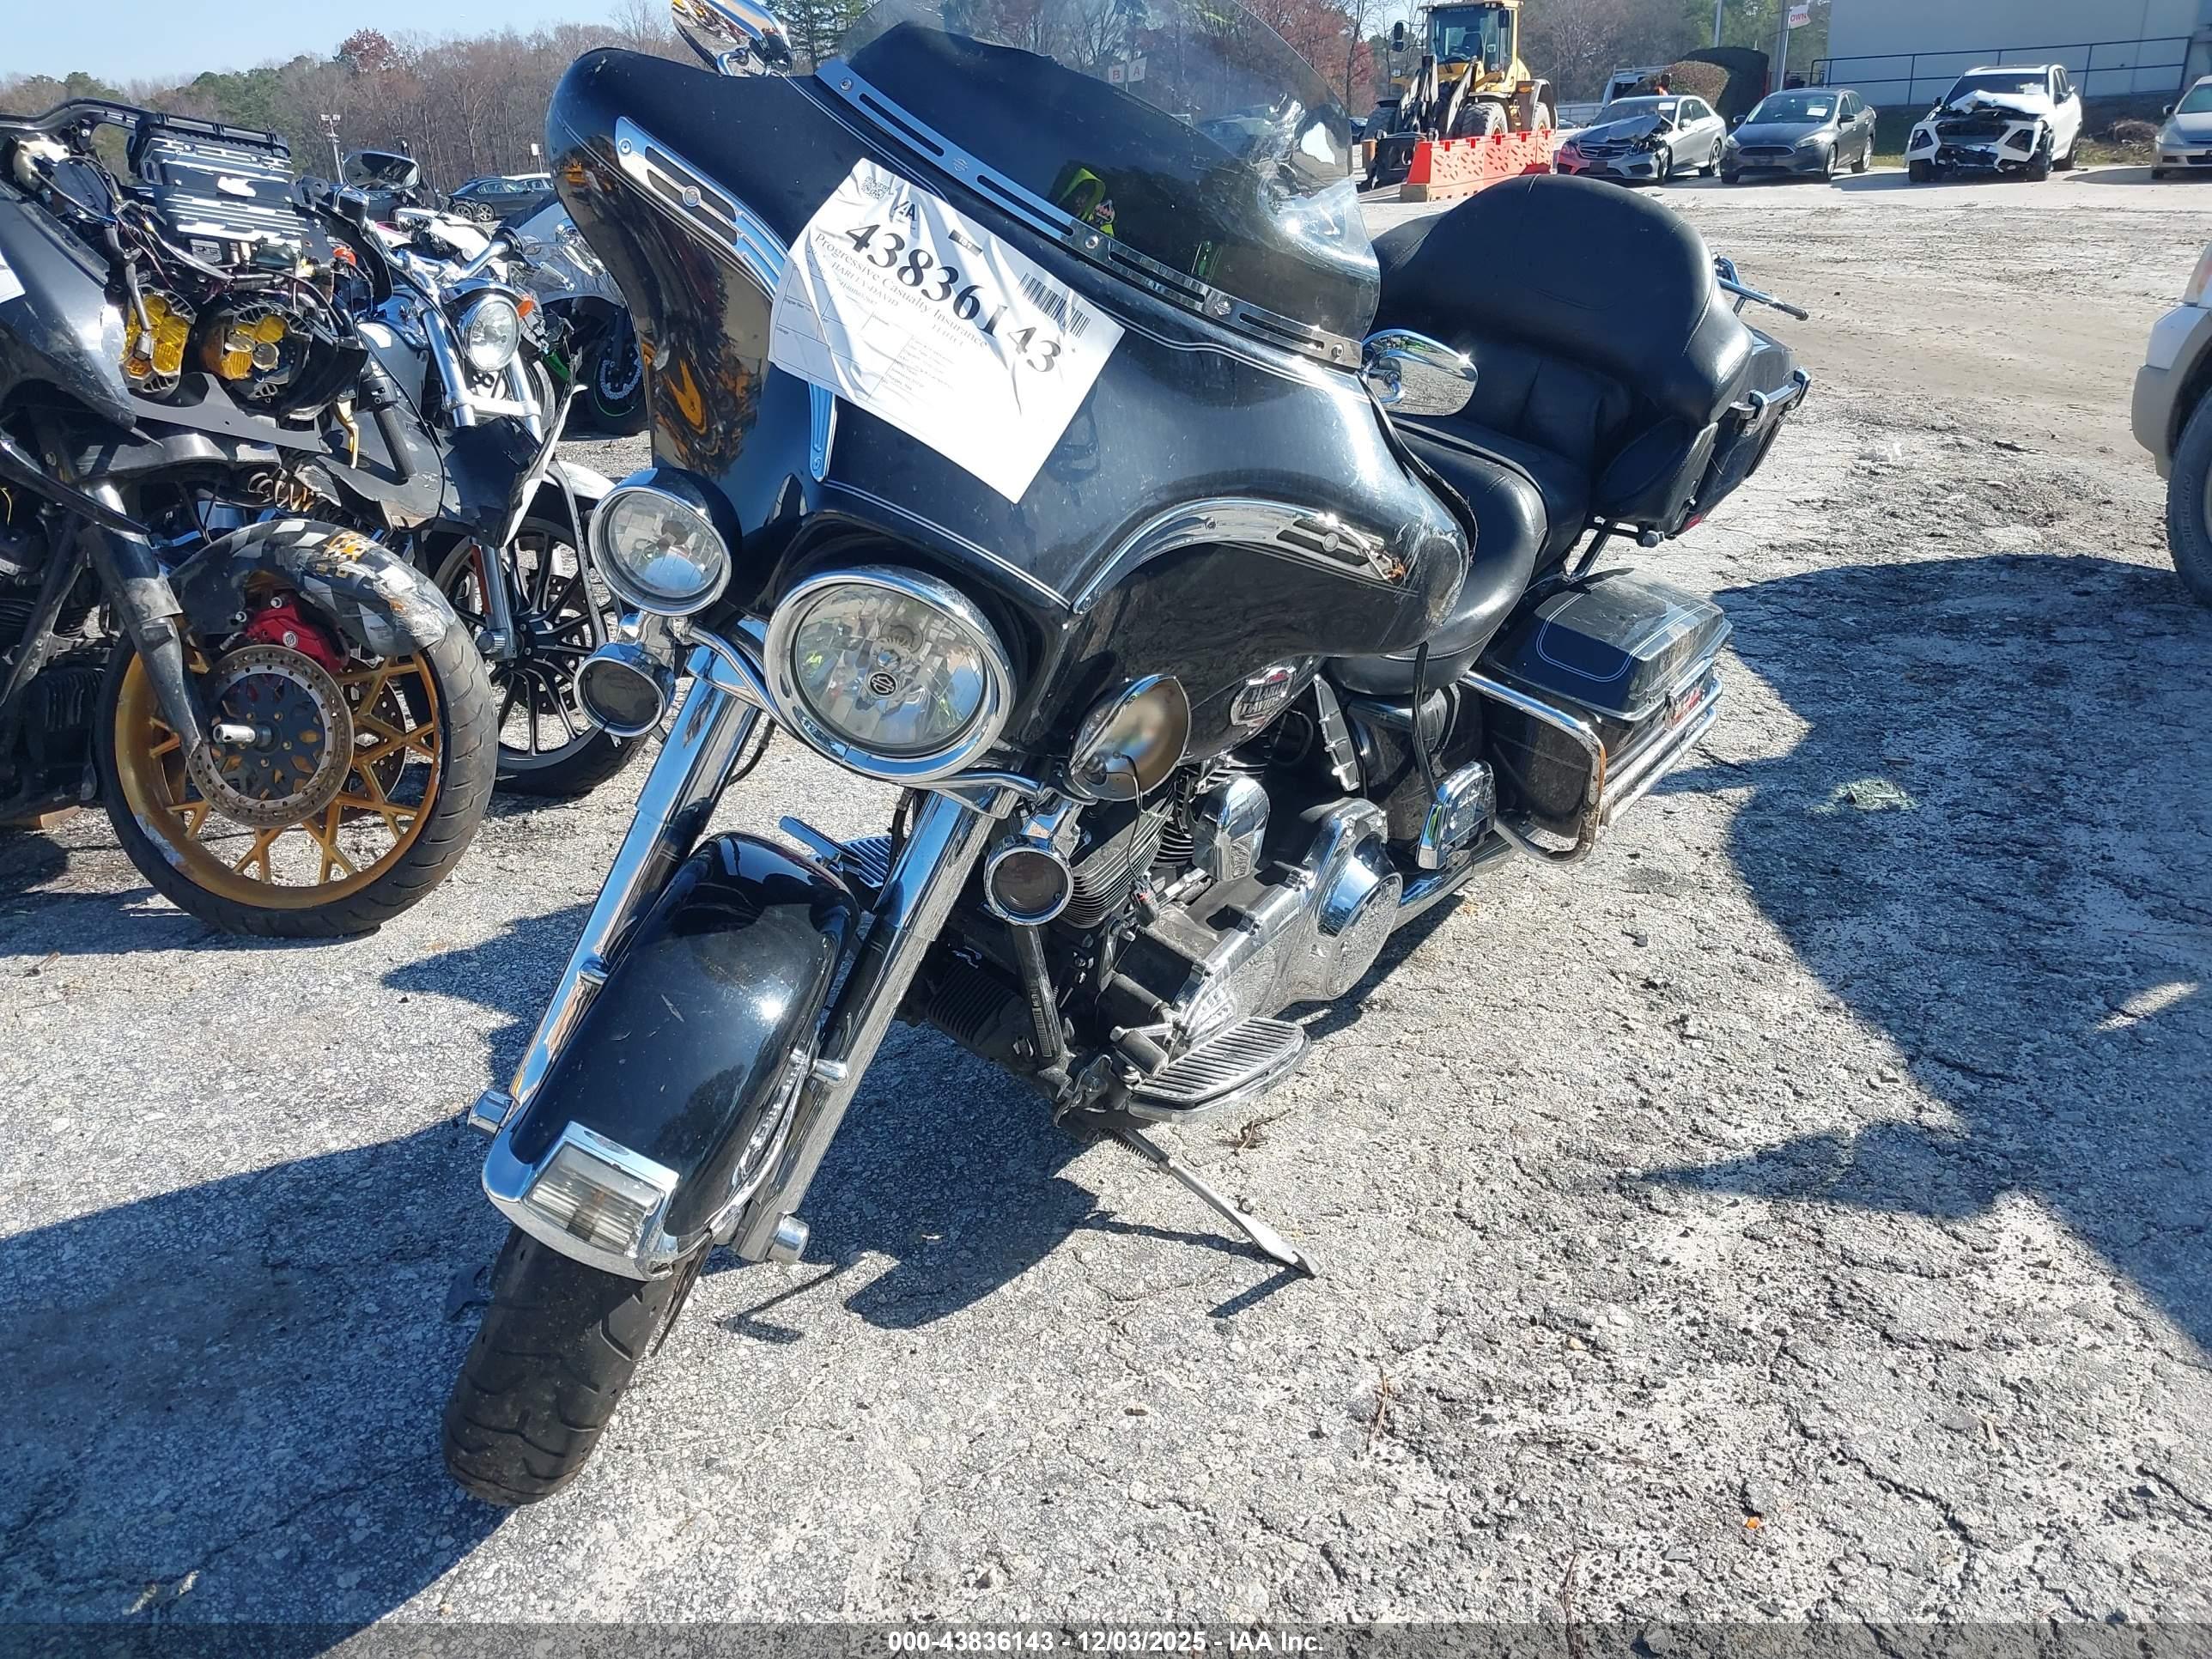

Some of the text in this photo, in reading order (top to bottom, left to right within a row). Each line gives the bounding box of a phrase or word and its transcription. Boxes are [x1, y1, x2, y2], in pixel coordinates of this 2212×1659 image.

[815, 233, 880, 281] Progressive
[882, 277, 931, 313] Casualty
[933, 308, 988, 348] Insurance
[845, 223, 1061, 373] 43836143
